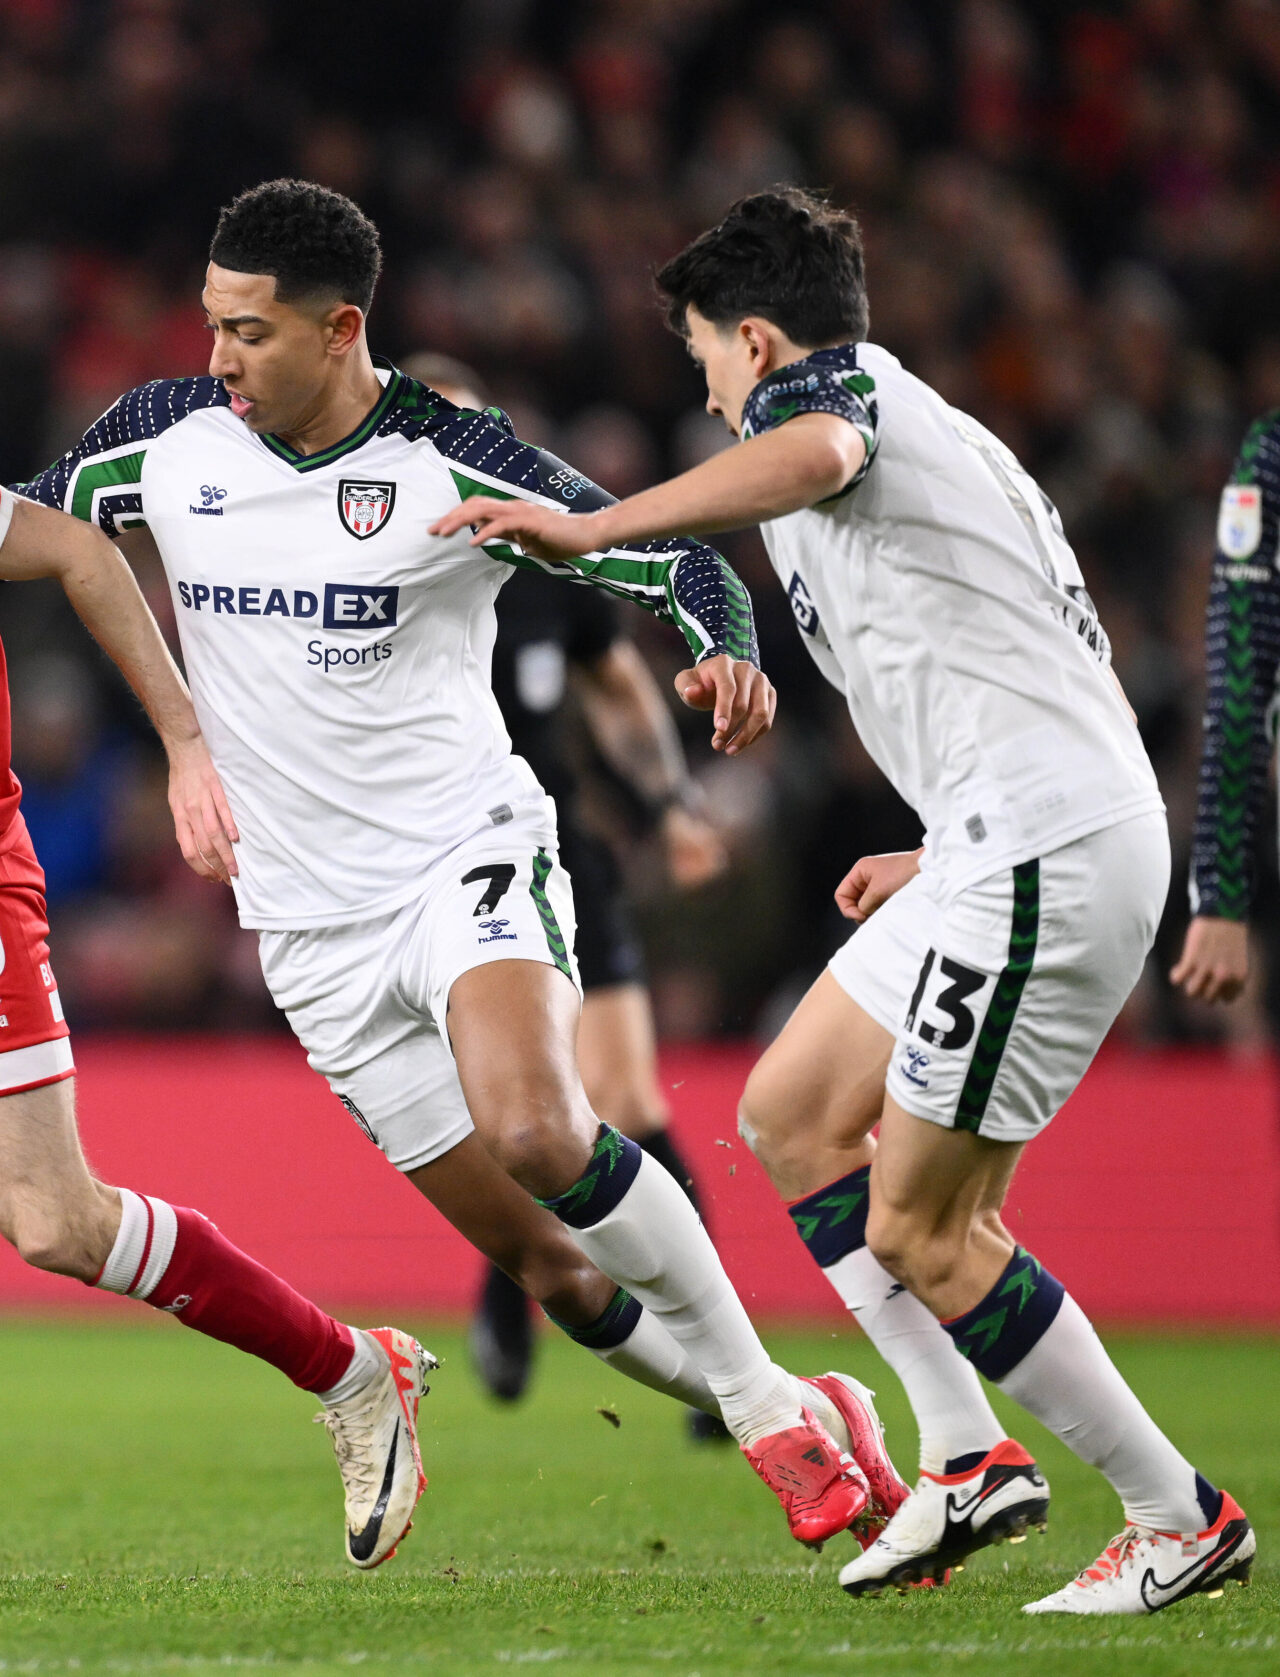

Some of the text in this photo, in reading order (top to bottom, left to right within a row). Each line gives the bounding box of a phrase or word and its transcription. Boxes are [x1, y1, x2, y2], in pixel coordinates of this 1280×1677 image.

[561, 477, 593, 499] GRO
[189, 504, 224, 516] hummel
[178, 580, 319, 620] SPREAD
[306, 640, 393, 673] Sports
[460, 863, 517, 917] 7
[478, 933, 518, 944] hummel
[904, 946, 989, 1051] 13
